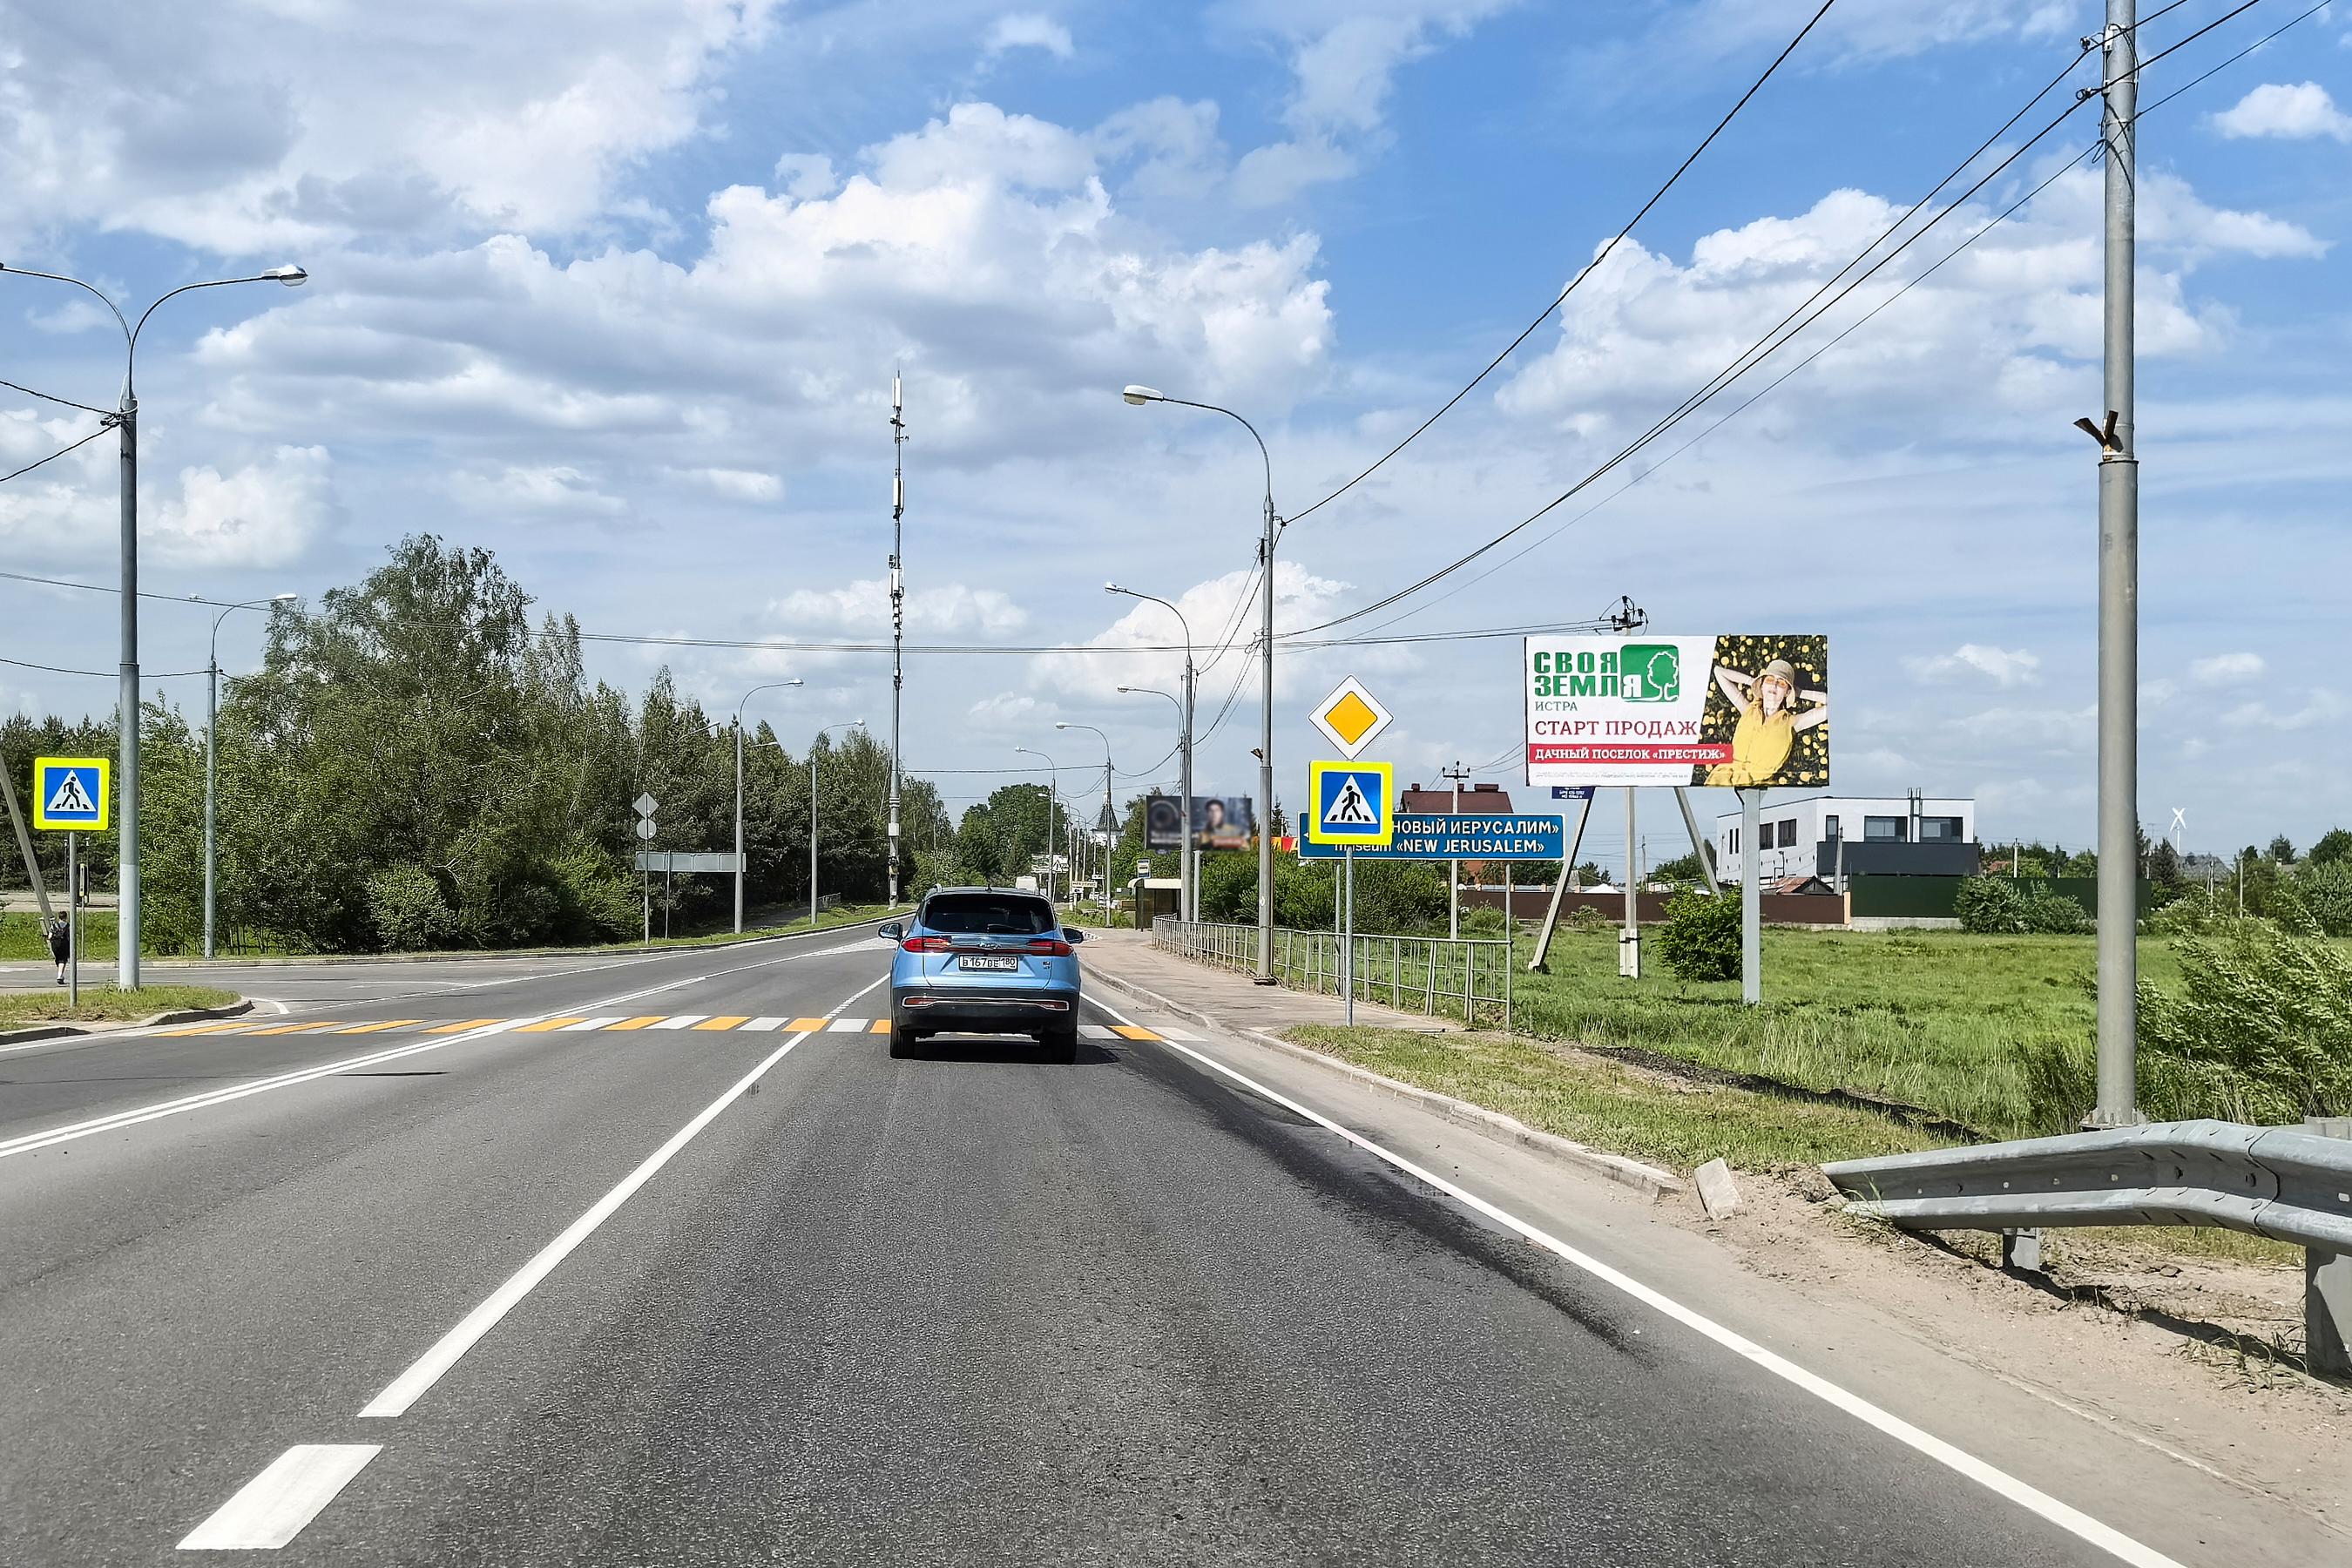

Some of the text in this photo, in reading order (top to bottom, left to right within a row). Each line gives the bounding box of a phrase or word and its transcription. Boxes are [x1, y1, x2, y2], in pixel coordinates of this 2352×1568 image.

[1534, 652, 1618, 673] СВОЯ
[1534, 674, 1642, 698] ЗЕМЛЯ
[1535, 700, 1578, 712] ИСТРА
[1535, 720, 1698, 739] СТАРТ ПРОДАЖ
[1535, 747, 1726, 760] ДАЧНЫЙ ПОСЕЛОК «ПРЕСТИЖ»
[1450, 821, 1559, 835] ИЕРУСАЛИМ»
[1396, 839, 1437, 853] «NEW
[1443, 839, 1544, 853] JERUSALEM»
